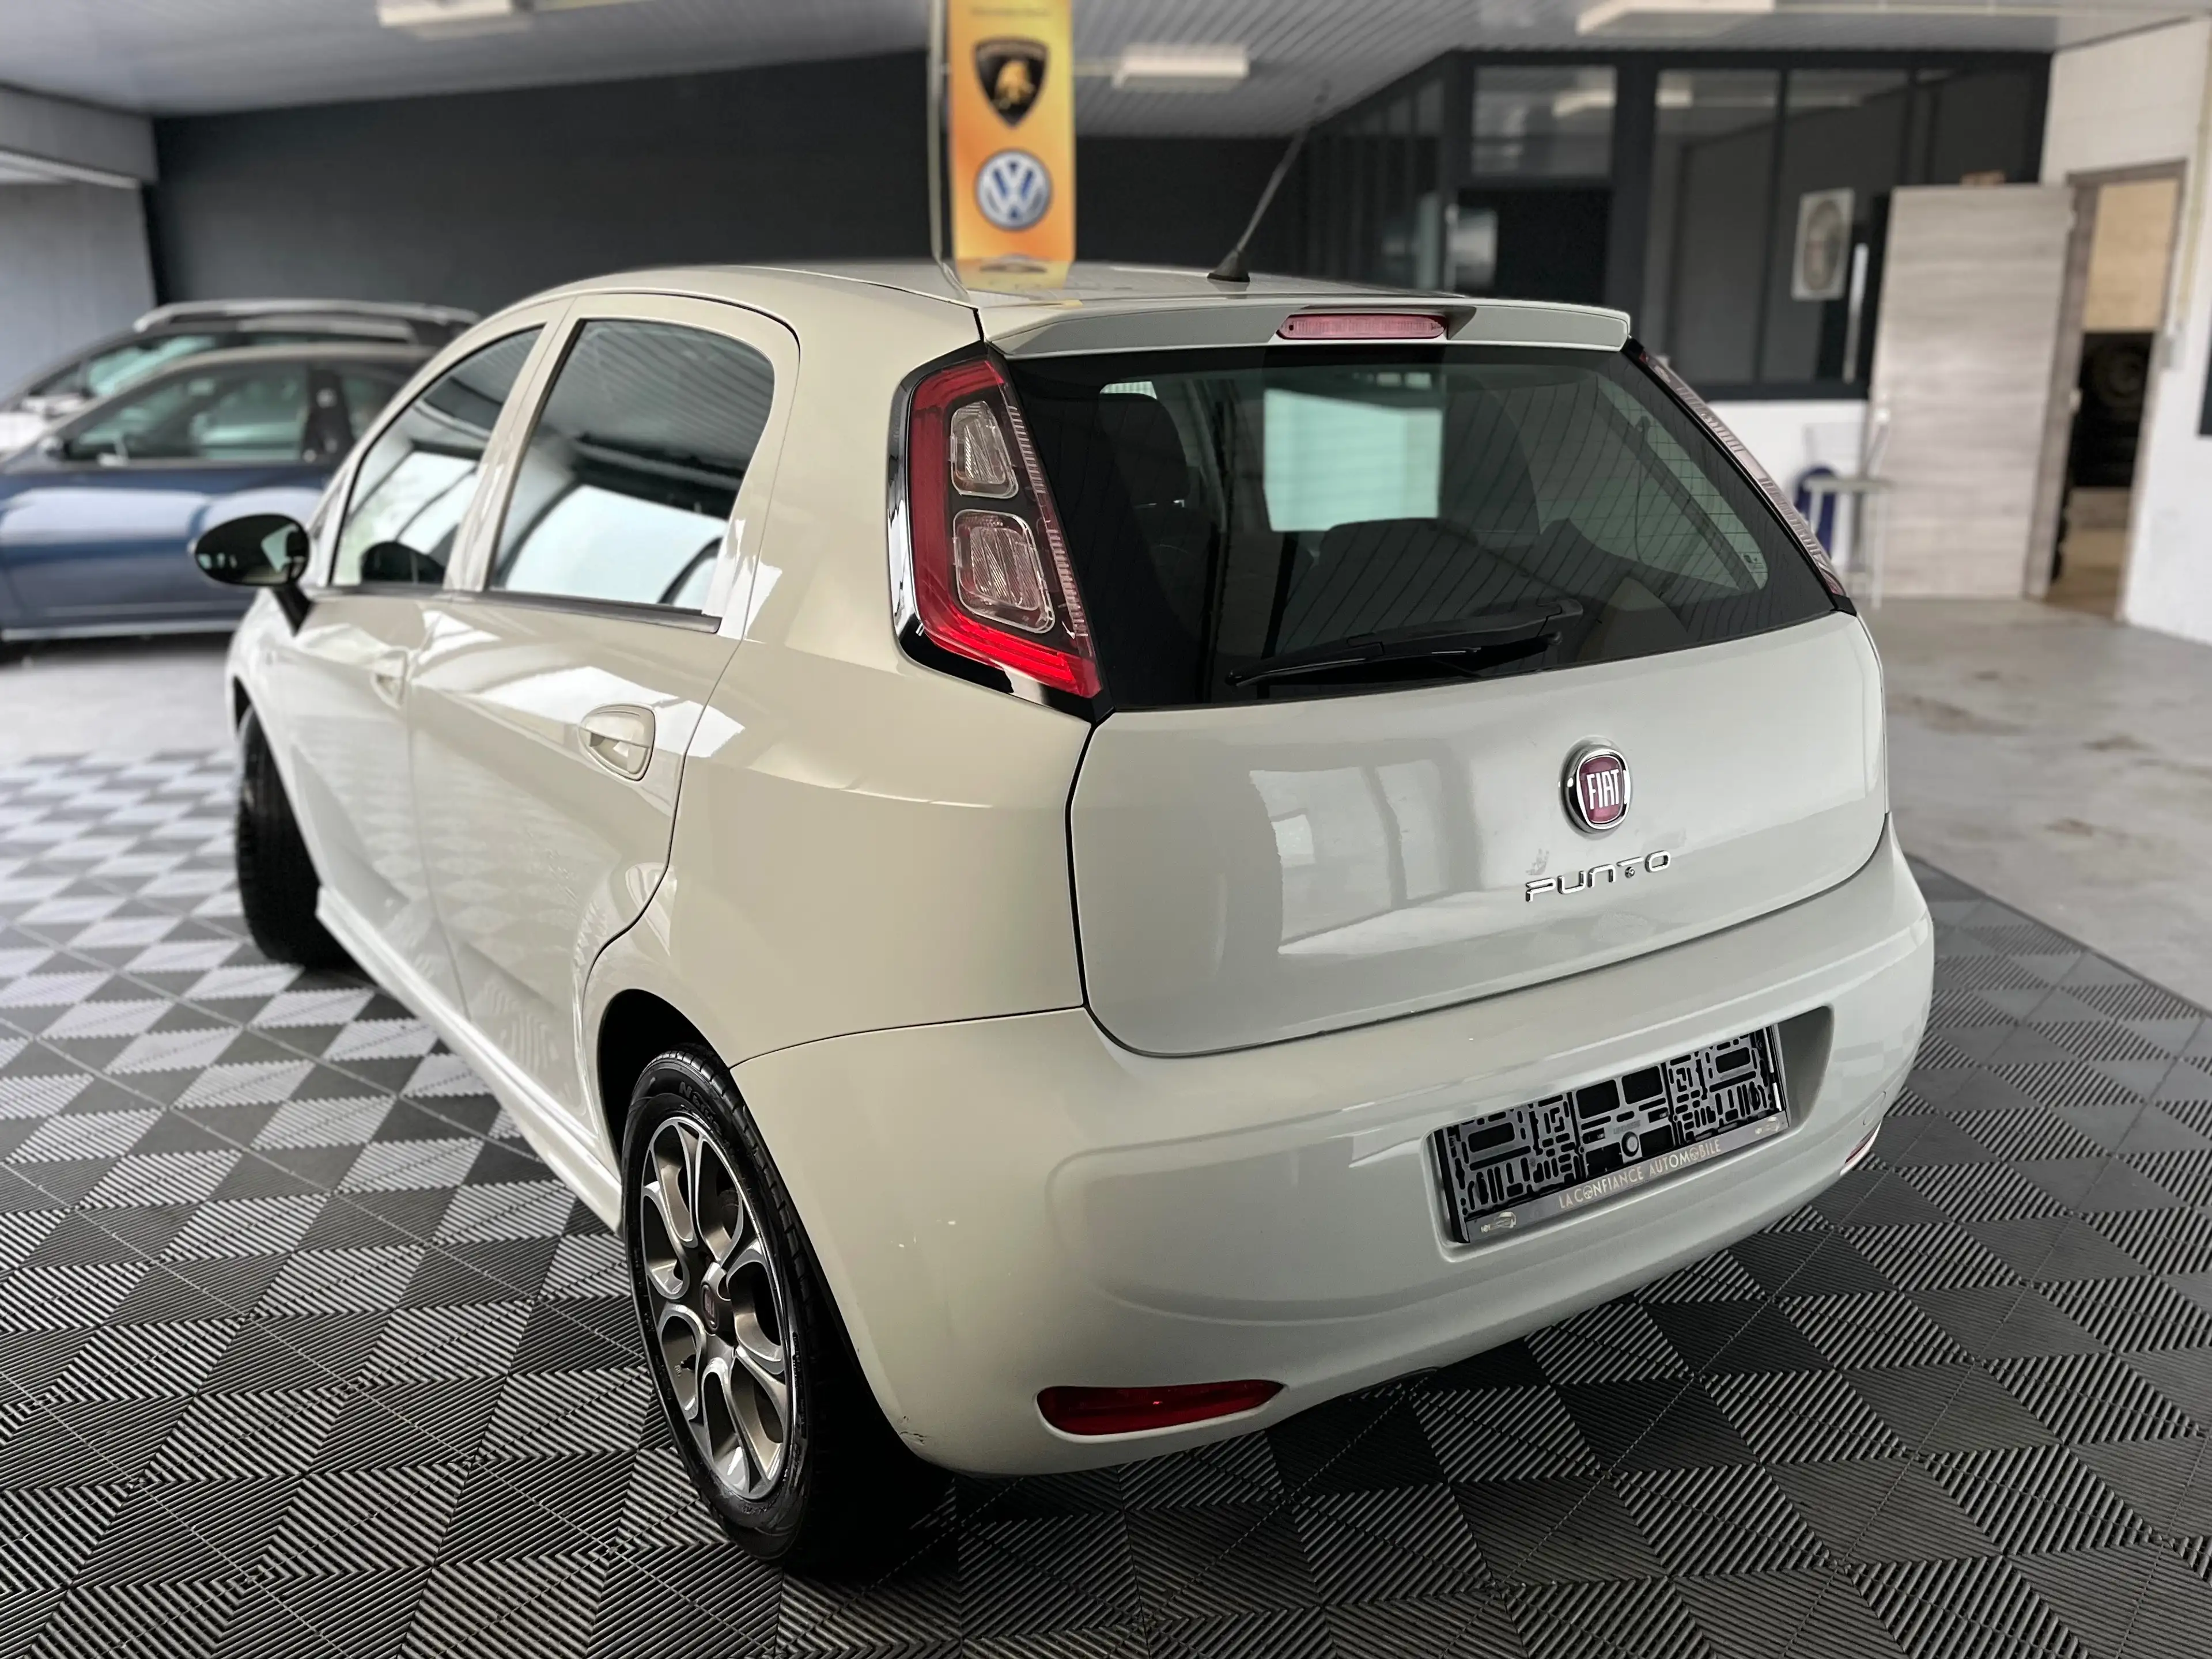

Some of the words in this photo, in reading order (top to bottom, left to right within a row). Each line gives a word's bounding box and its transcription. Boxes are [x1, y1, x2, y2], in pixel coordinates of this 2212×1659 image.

[1586, 768, 1620, 810] FIAT
[1525, 850, 1672, 903] PUNTO
[1559, 1195, 1574, 1209] LA
[1574, 1166, 1644, 1203] CONFIANCE
[1648, 1139, 1721, 1178] AUTOMOBILE
